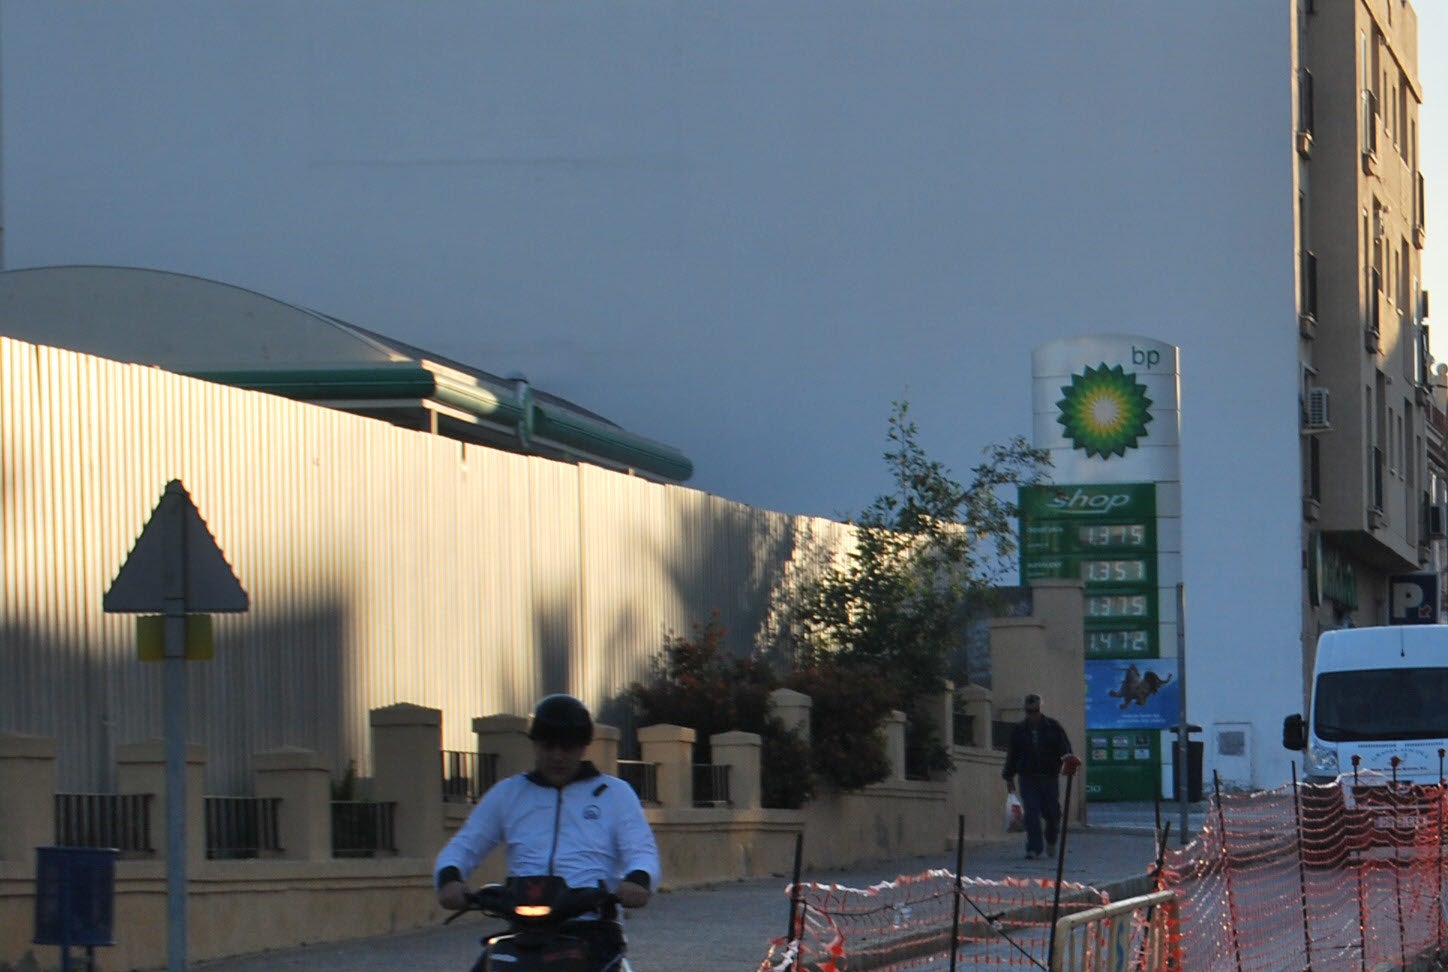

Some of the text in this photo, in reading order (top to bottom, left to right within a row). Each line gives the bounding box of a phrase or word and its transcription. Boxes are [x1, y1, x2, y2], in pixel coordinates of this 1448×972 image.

[1132, 346, 1160, 369] bp
[1047, 488, 1131, 514] shop
[1392, 582, 1424, 618] P
